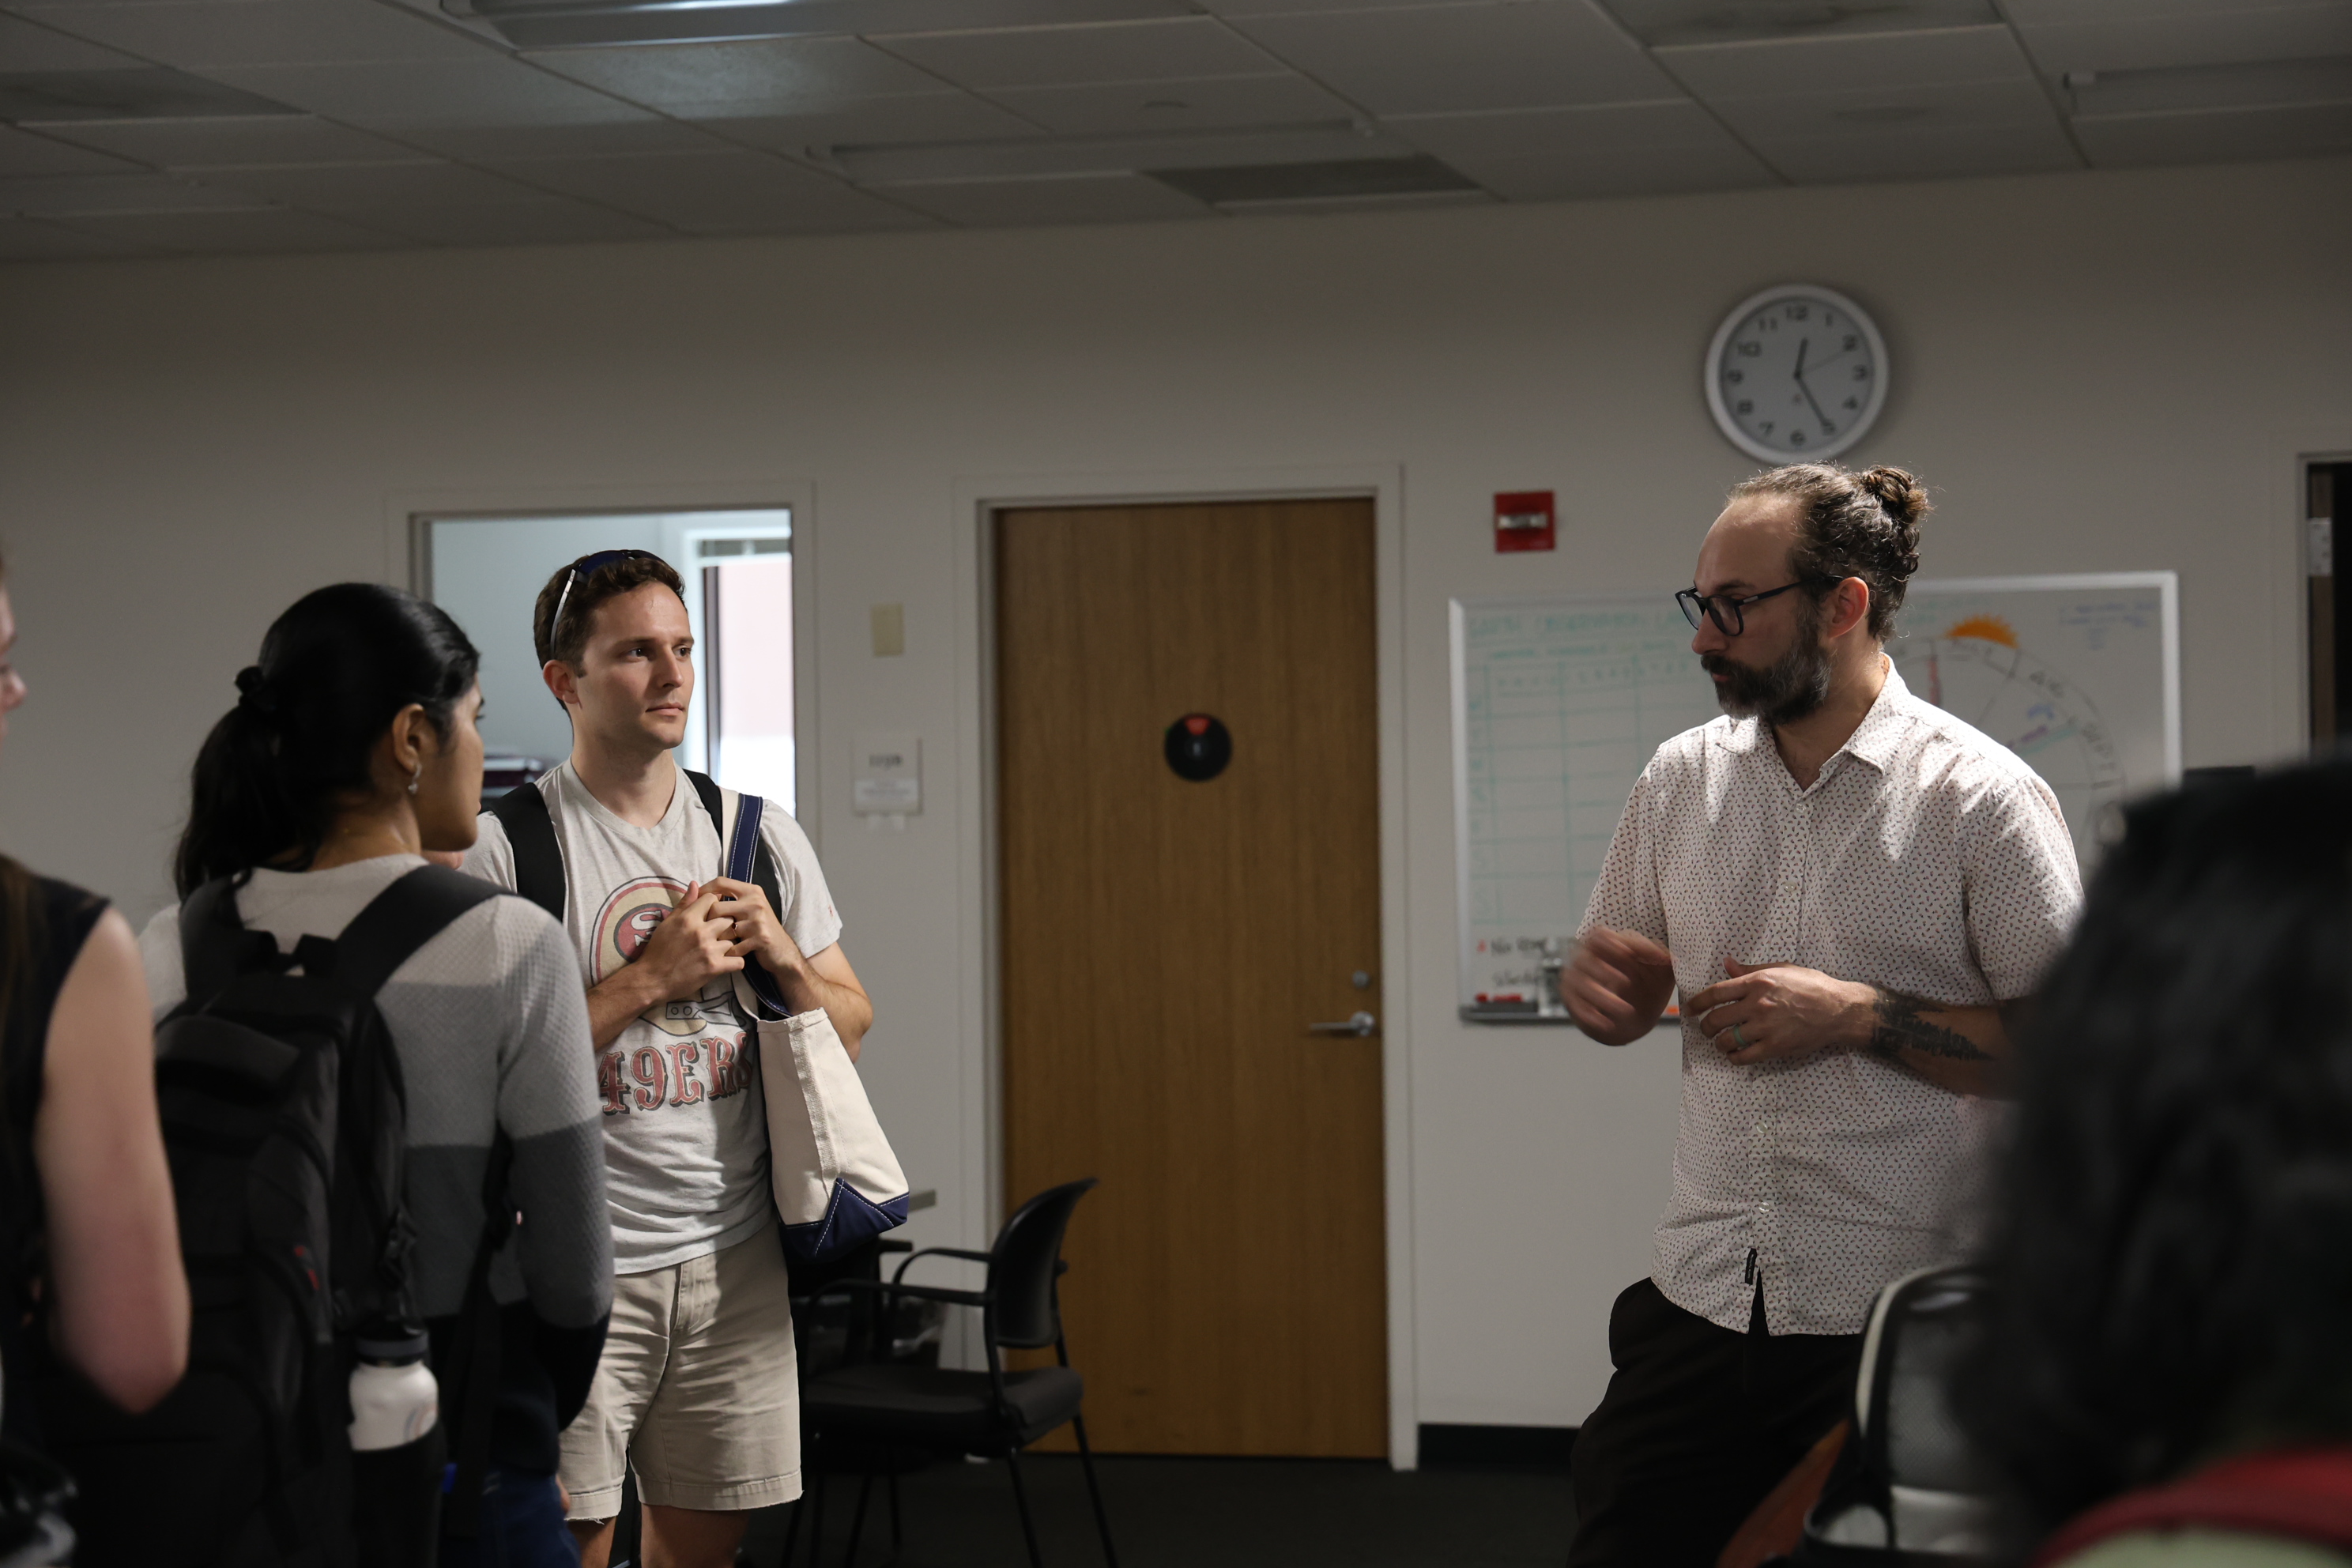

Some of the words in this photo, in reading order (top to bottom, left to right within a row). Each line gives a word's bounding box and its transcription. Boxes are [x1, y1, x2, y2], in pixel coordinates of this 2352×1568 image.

[1786, 305, 1807, 321] 12
[1760, 317, 1777, 332] 11
[1738, 341, 1761, 357] 10
[1853, 364, 1868, 380] 3
[1759, 421, 1773, 435] 7
[597, 1031, 752, 1116] 49ERS
